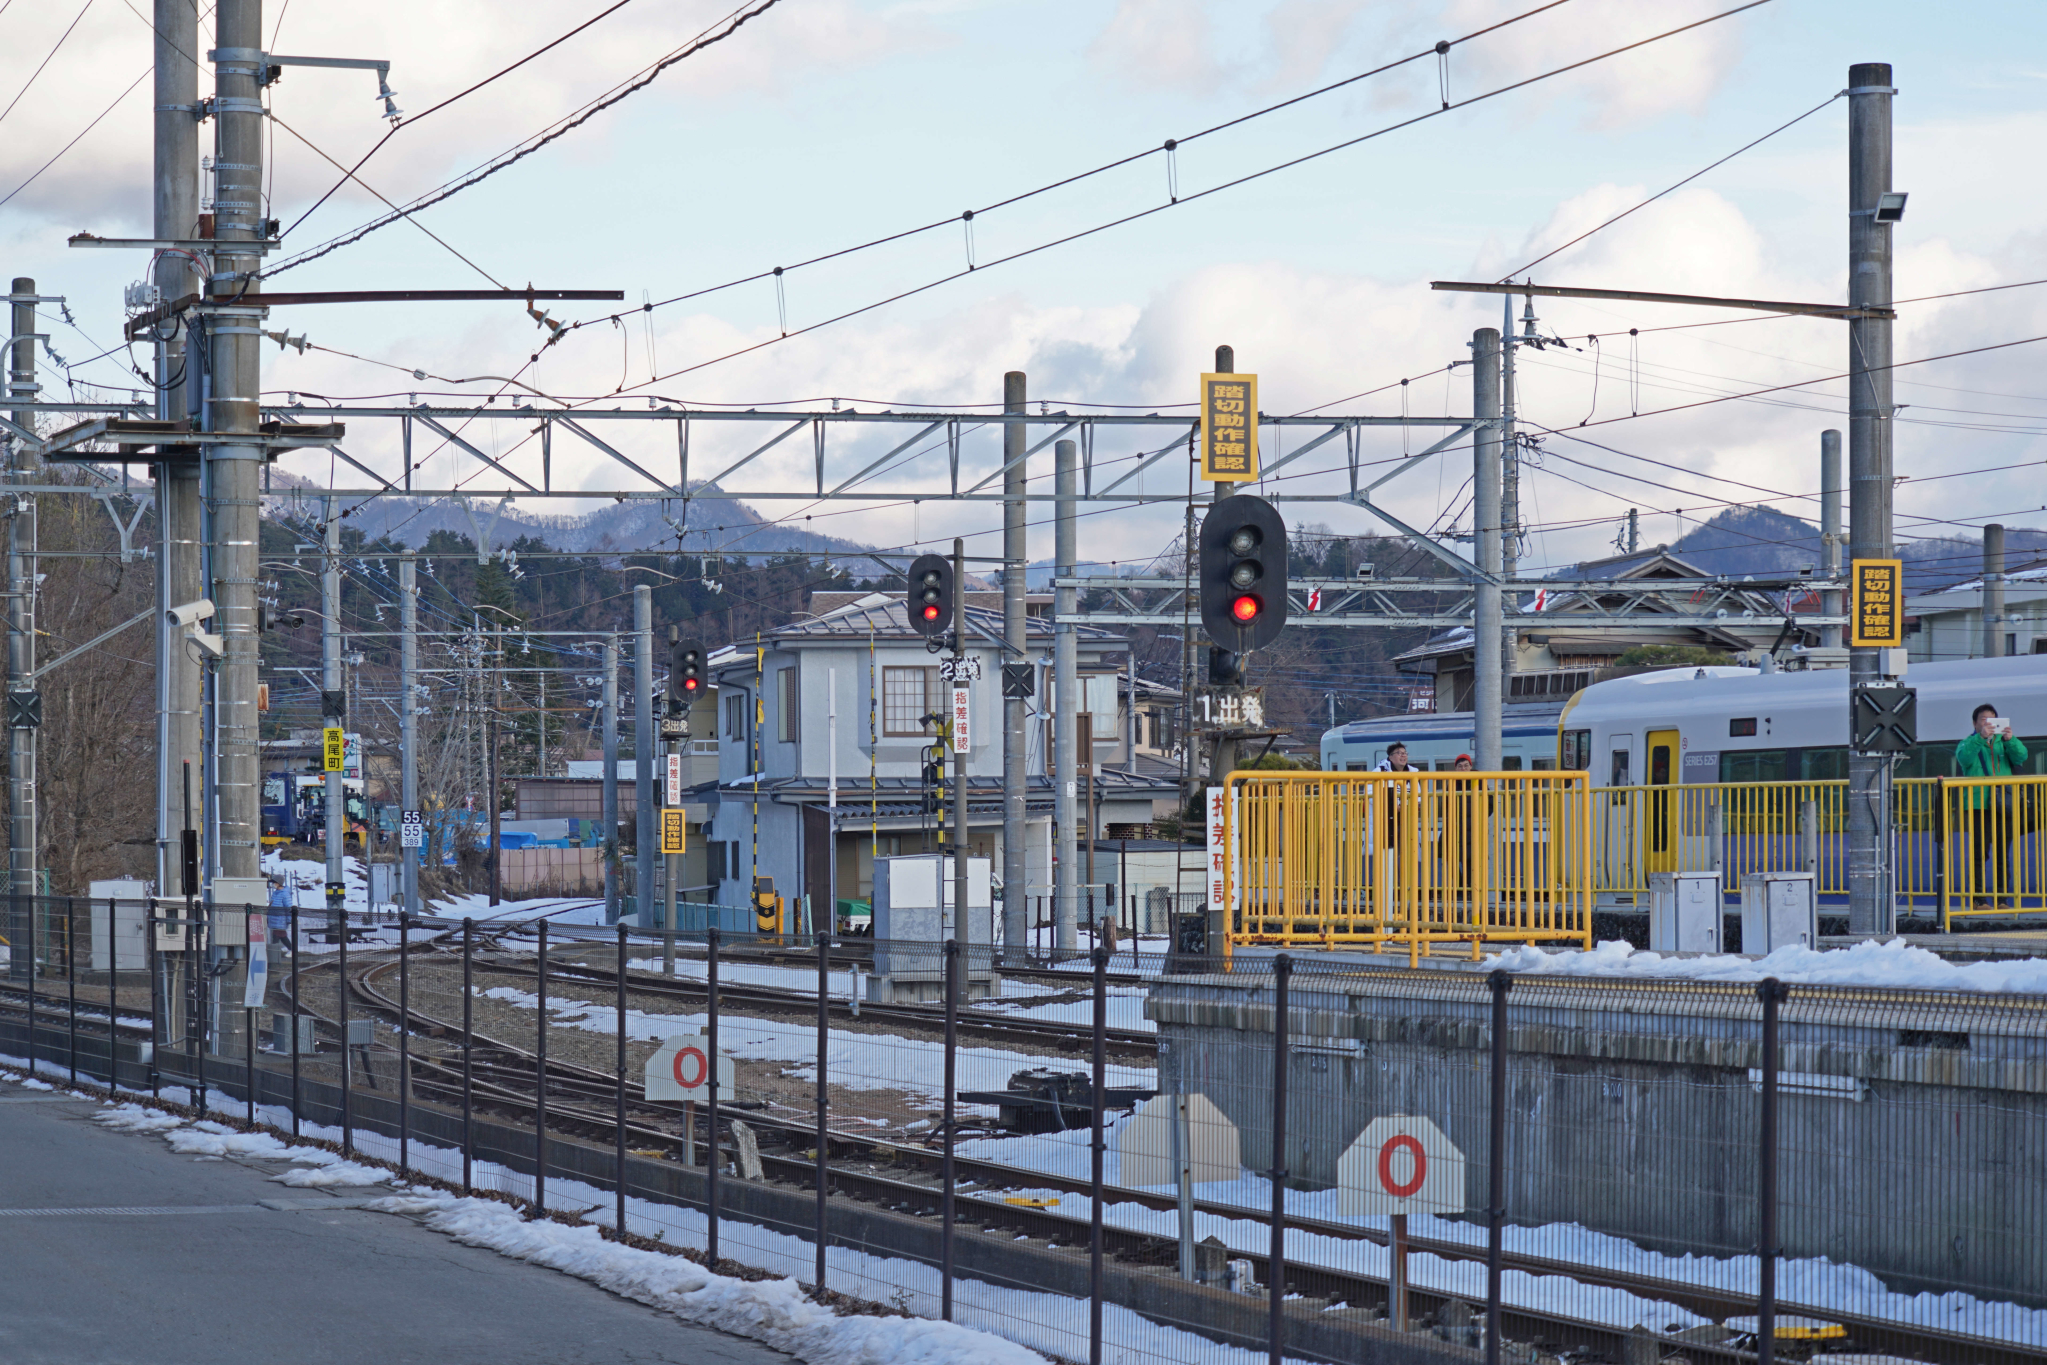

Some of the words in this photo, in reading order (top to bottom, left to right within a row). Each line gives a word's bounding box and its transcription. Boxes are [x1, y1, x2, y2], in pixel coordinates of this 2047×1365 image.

[1213, 384, 1246, 470] 踏切動作確認
[1863, 568, 1891, 637] 踏切動作確認
[941, 661, 979, 680] 2出発
[955, 691, 968, 750] 指差確認
[1202, 694, 1263, 725] 1出発
[661, 718, 689, 732] 3出発
[327, 729, 340, 769] 高尾町
[1685, 755, 1703, 766] SERIES
[1704, 754, 1718, 765] E257
[669, 756, 679, 803] 指差確認
[403, 811, 420, 823] 55
[404, 825, 420, 837] 55
[404, 838, 419, 846] 389
[667, 814, 680, 849] 踏切動作確認
[1787, 882, 1793, 892] 2
